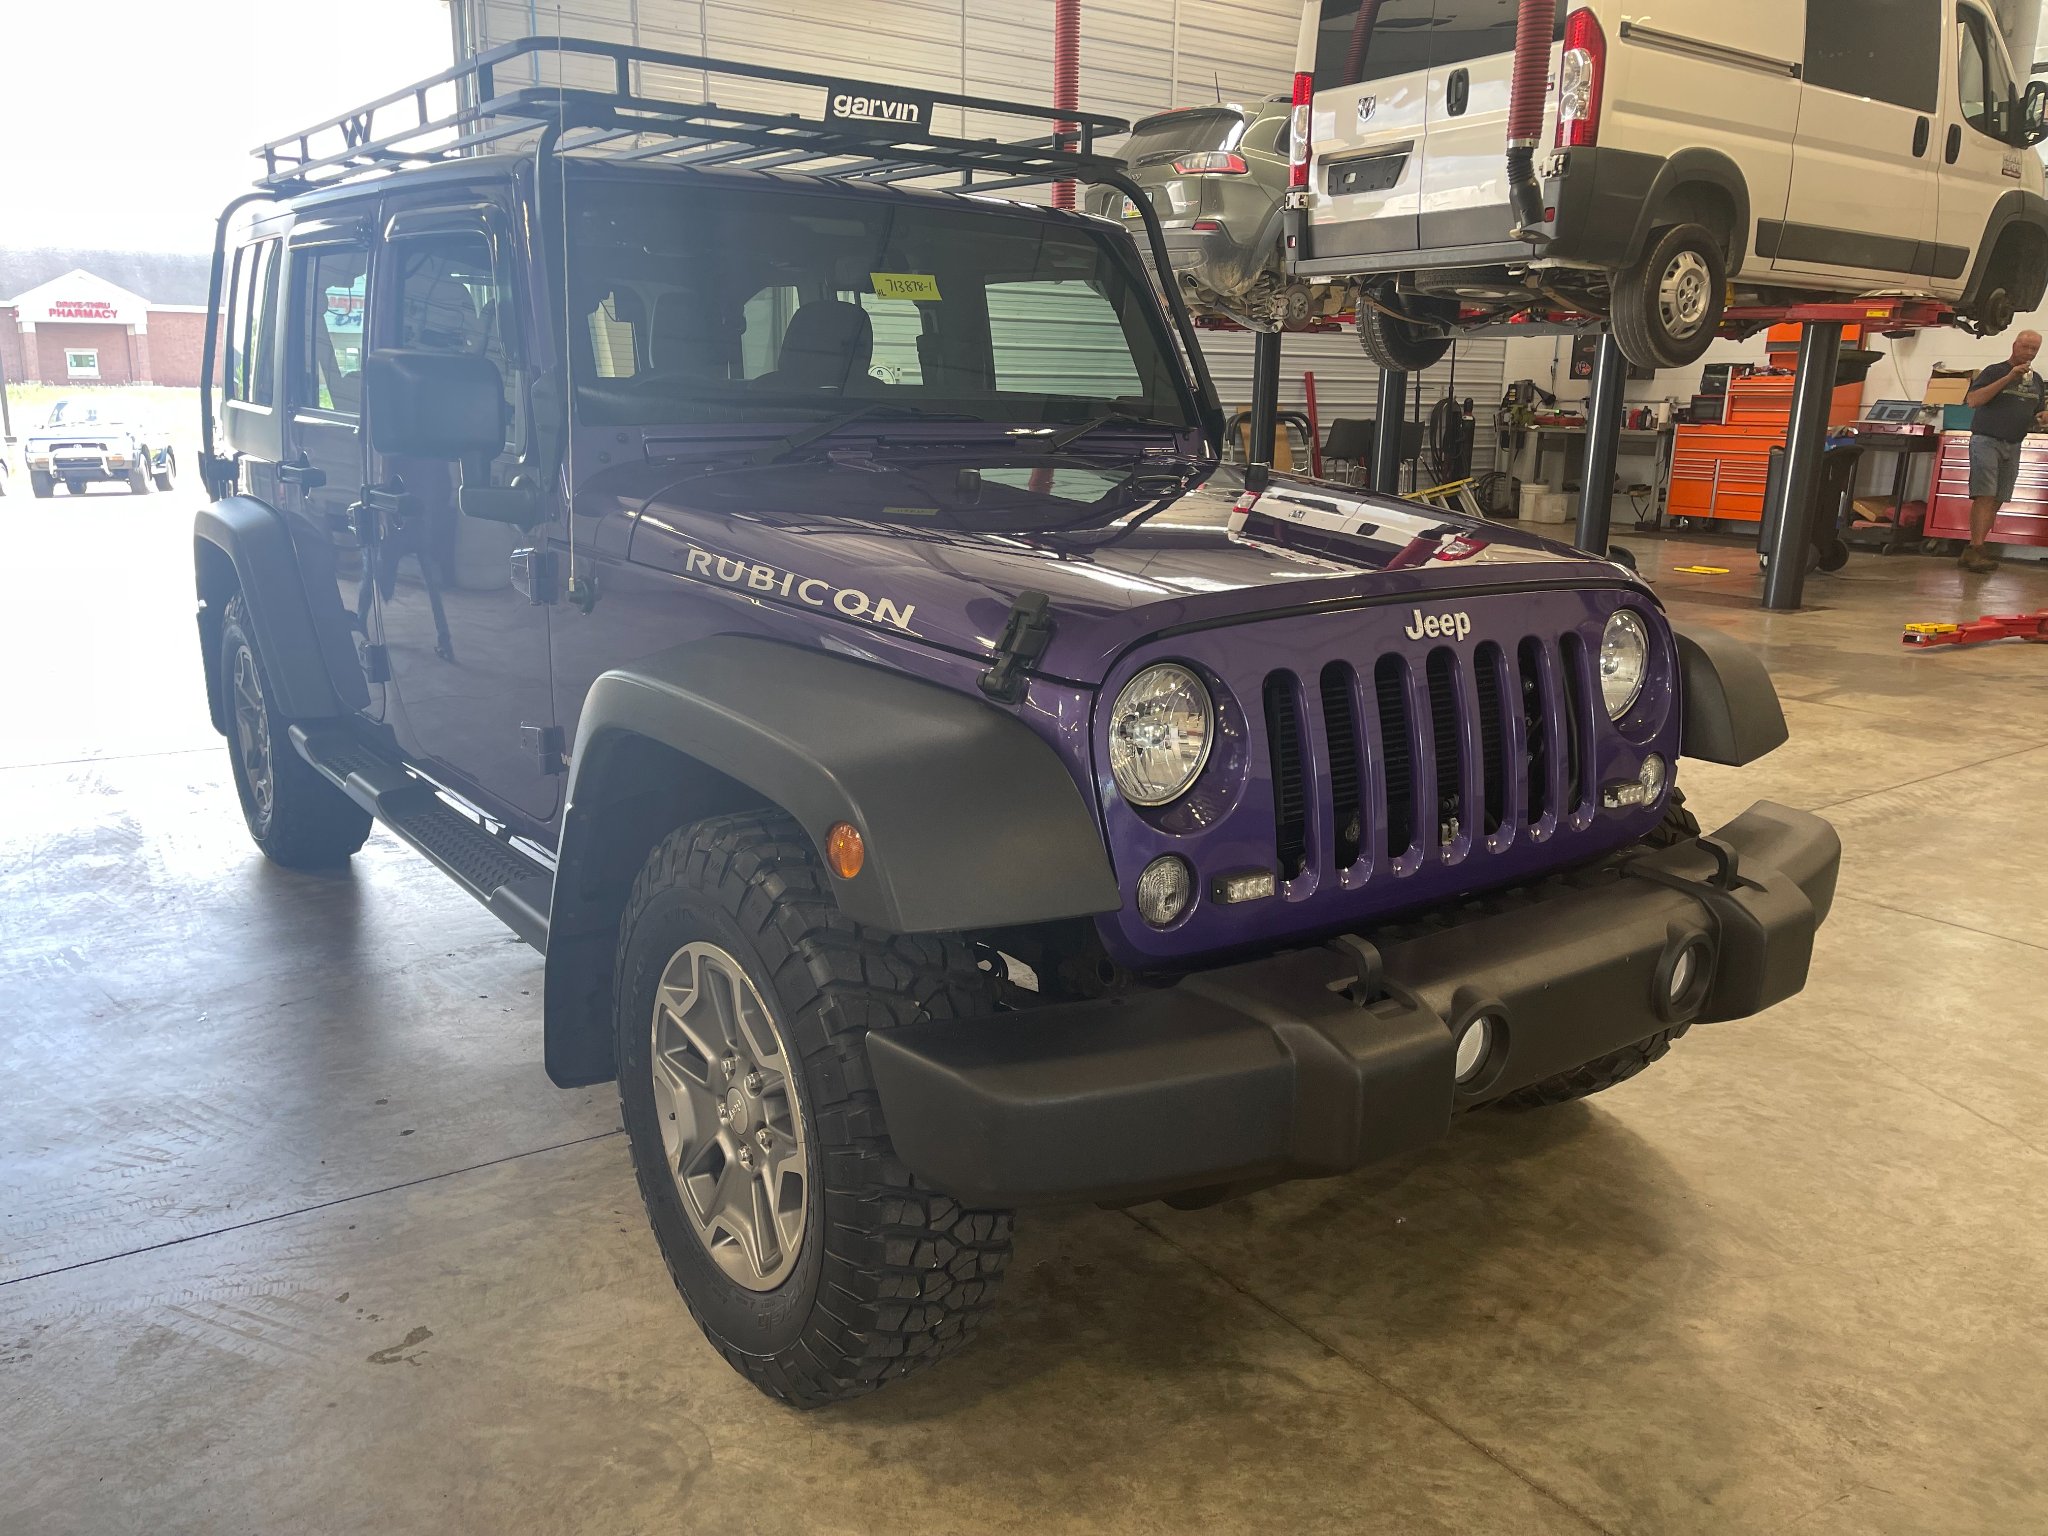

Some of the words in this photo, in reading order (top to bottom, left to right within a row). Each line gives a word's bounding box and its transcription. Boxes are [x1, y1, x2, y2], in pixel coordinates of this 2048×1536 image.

[833, 94, 919, 122] garvin
[48, 308, 118, 319] PHARMACY
[685, 549, 915, 629] RUBICON
[1404, 609, 1471, 642] Jeep
